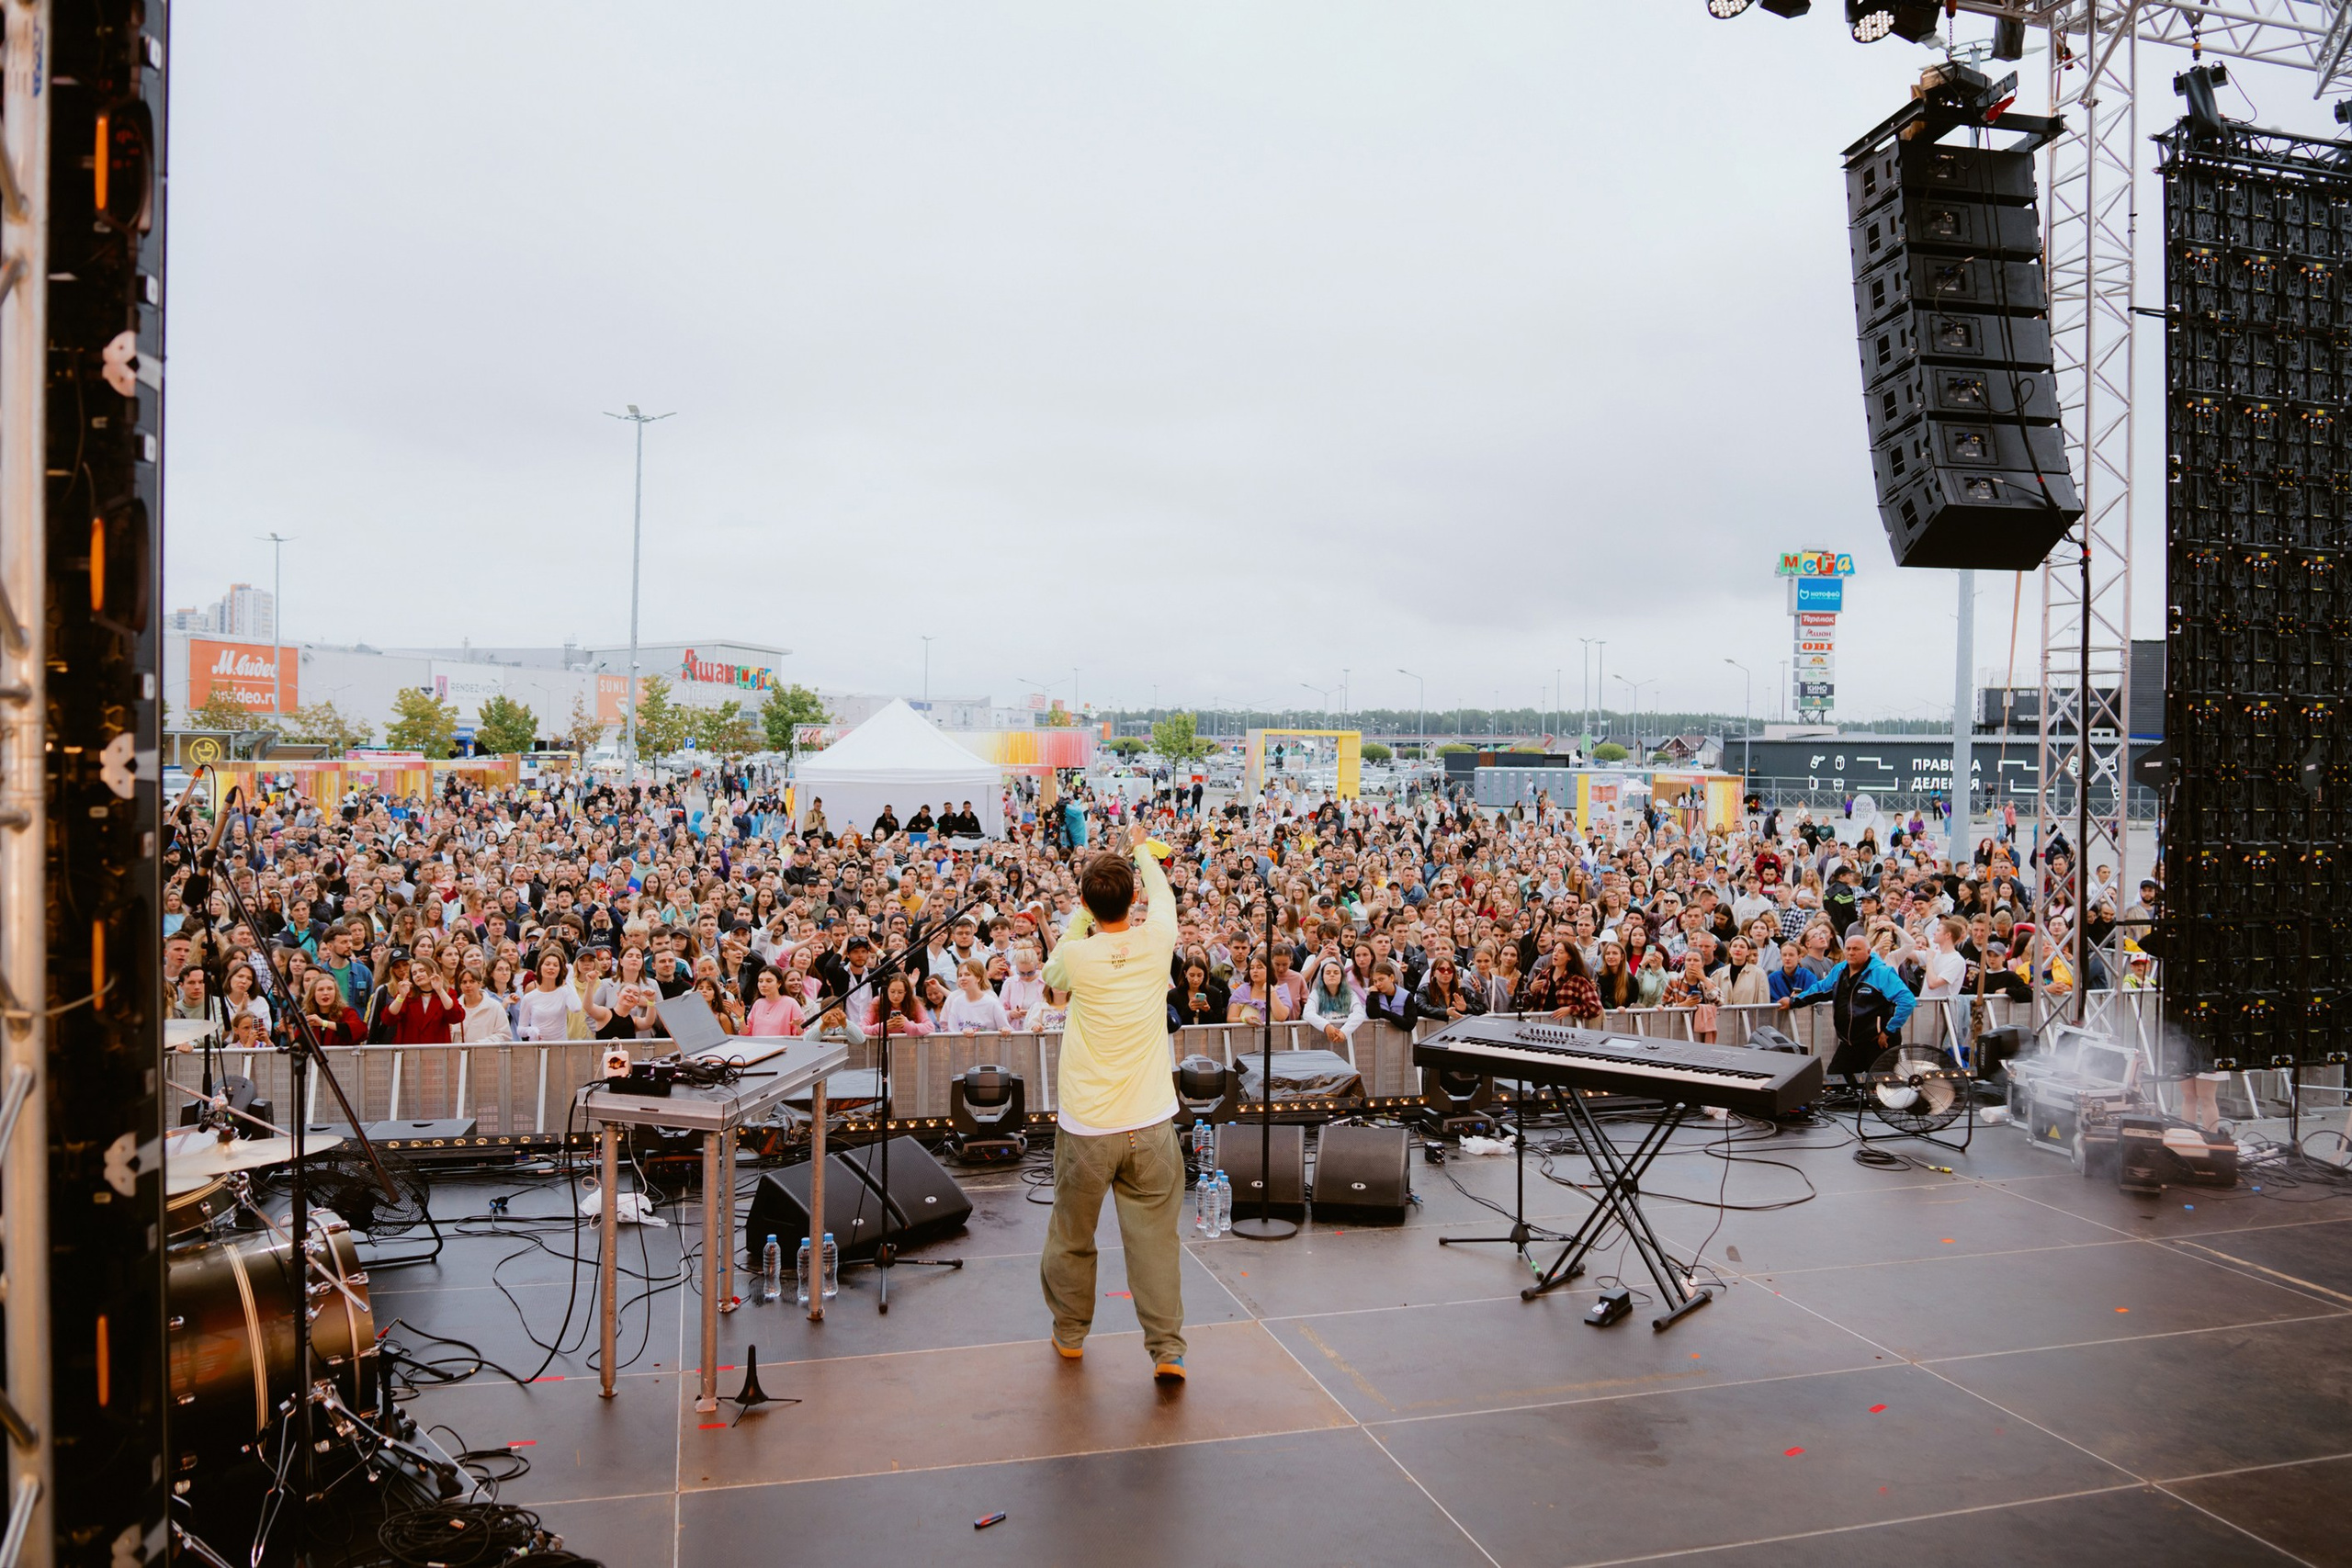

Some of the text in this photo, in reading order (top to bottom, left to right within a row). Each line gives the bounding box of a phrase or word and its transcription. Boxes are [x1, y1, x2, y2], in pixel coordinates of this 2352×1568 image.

[1803, 615, 1834, 624] Теремок
[1806, 628, 1831, 637] Ашан
[1802, 642, 1833, 650] OBI
[682, 649, 735, 683] Ашан
[450, 682, 501, 694] RENDEZ-VOUS
[600, 679, 647, 695] SUNLIH
[1912, 759, 1982, 772] ПРАВА
[1911, 777, 1980, 792] ДЕЛЕНЯ
